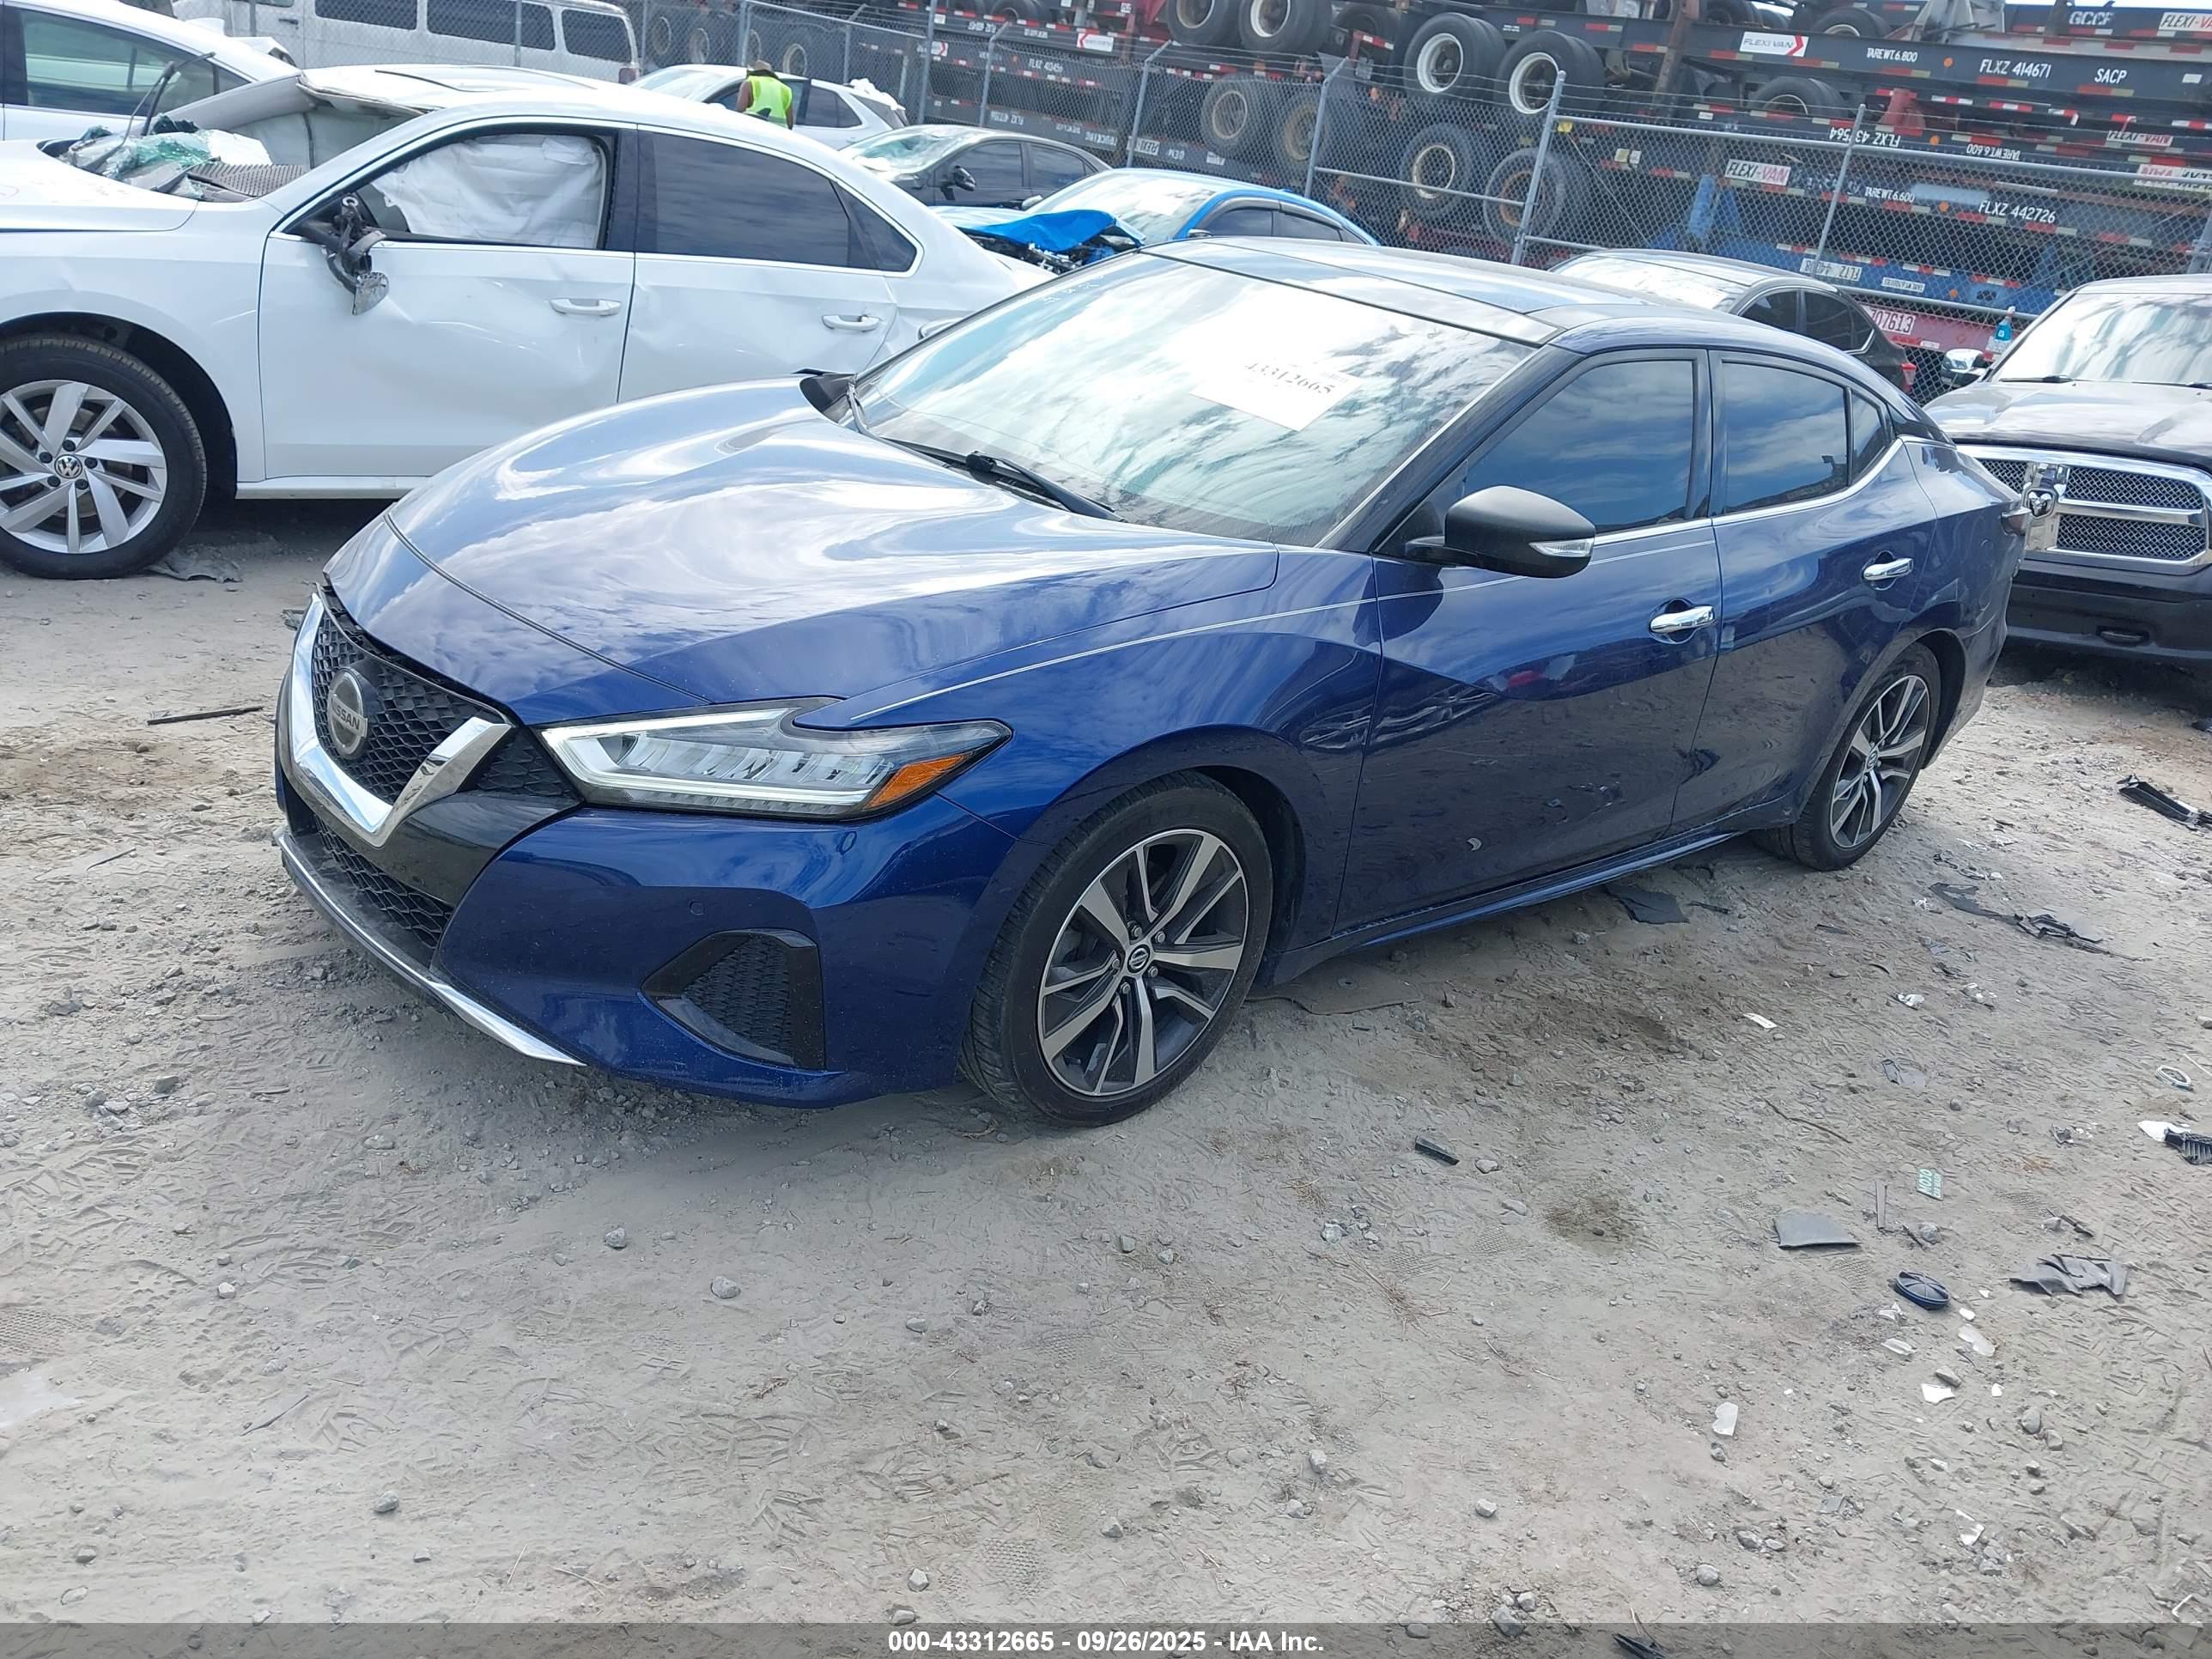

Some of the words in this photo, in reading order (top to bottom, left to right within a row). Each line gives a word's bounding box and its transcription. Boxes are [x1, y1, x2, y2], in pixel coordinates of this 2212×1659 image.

[1978, 59, 2011, 75] FLXZ
[2012, 61, 2052, 78] 414671
[2094, 68, 2128, 84] SACP
[1828, 126, 1870, 143] 43564
[1872, 131, 1902, 148] FLXZ
[1728, 161, 1789, 184] FLEXI-VAN
[1978, 200, 2009, 216] FLXZ
[2010, 205, 2057, 224] 442726
[331, 697, 361, 731] NISSAN
[1918, 1168, 1933, 1195] MOJO
